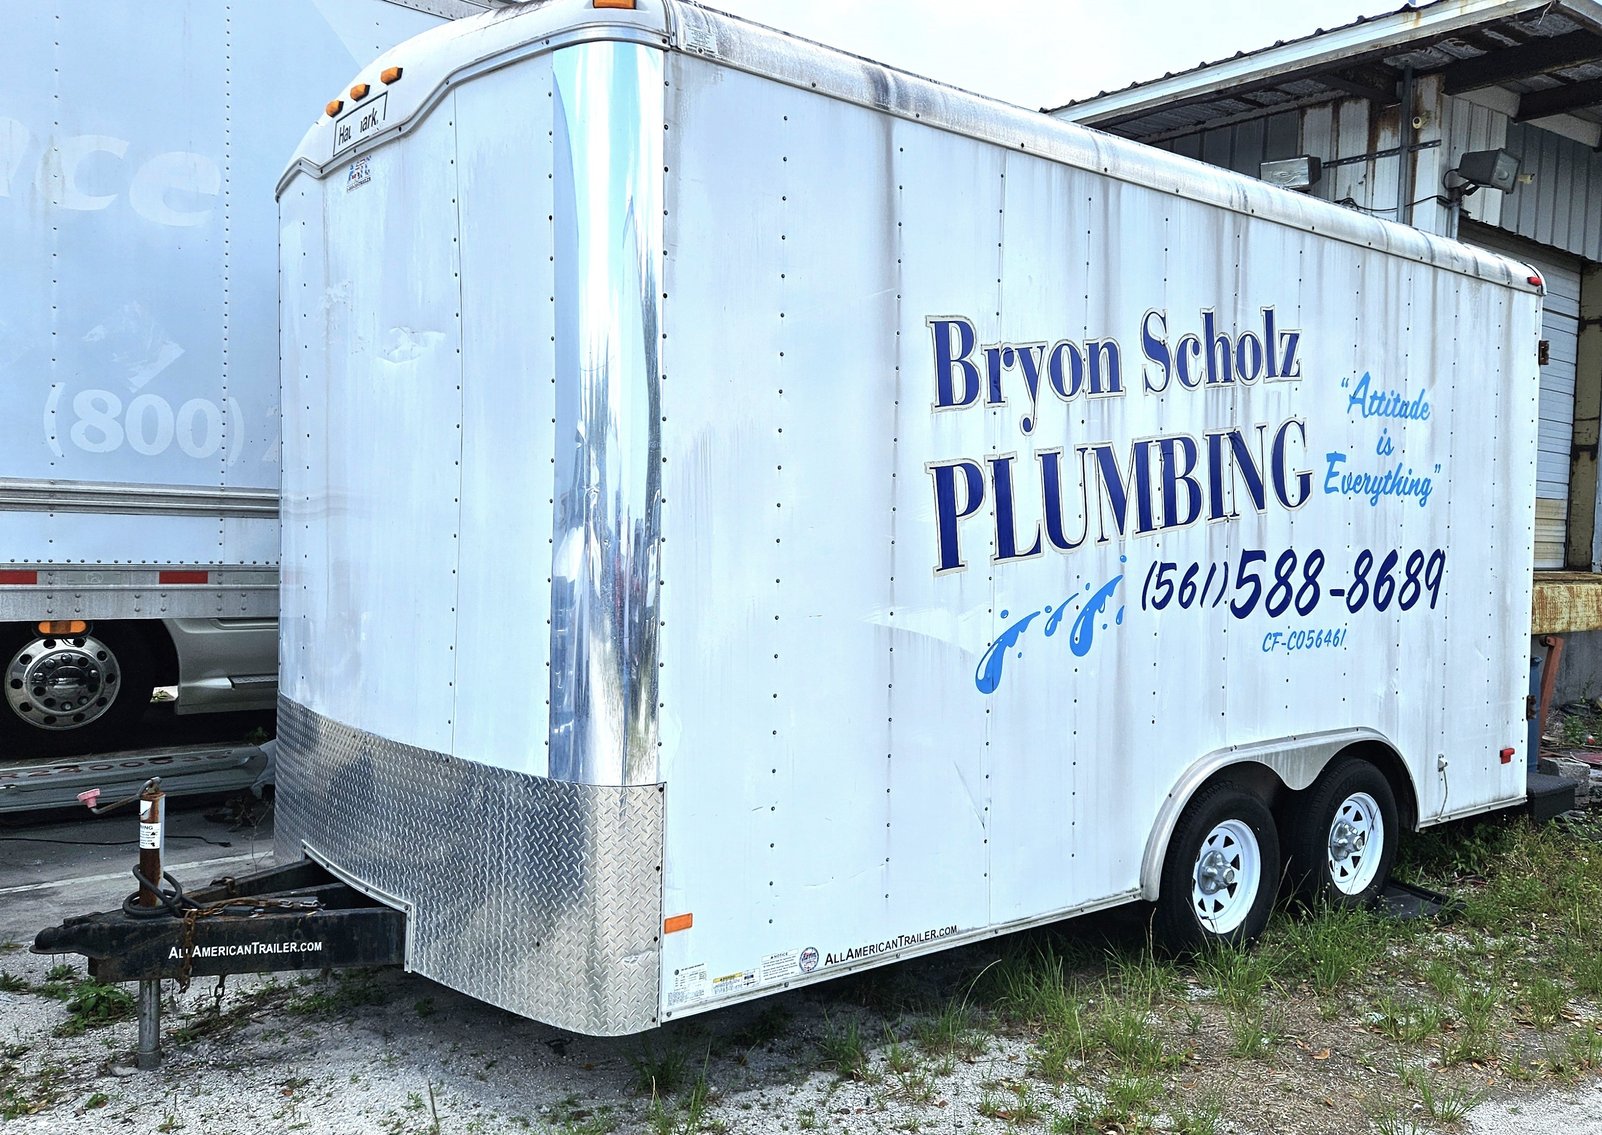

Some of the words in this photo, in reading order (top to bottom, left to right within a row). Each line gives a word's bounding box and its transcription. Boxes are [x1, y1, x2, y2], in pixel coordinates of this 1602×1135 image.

[44, 381, 245, 467] (800)
[924, 314, 1126, 436] Bryon
[1140, 304, 1303, 396] Scholz
[1376, 427, 1395, 456] is
[924, 417, 1315, 577] PLUMBING
